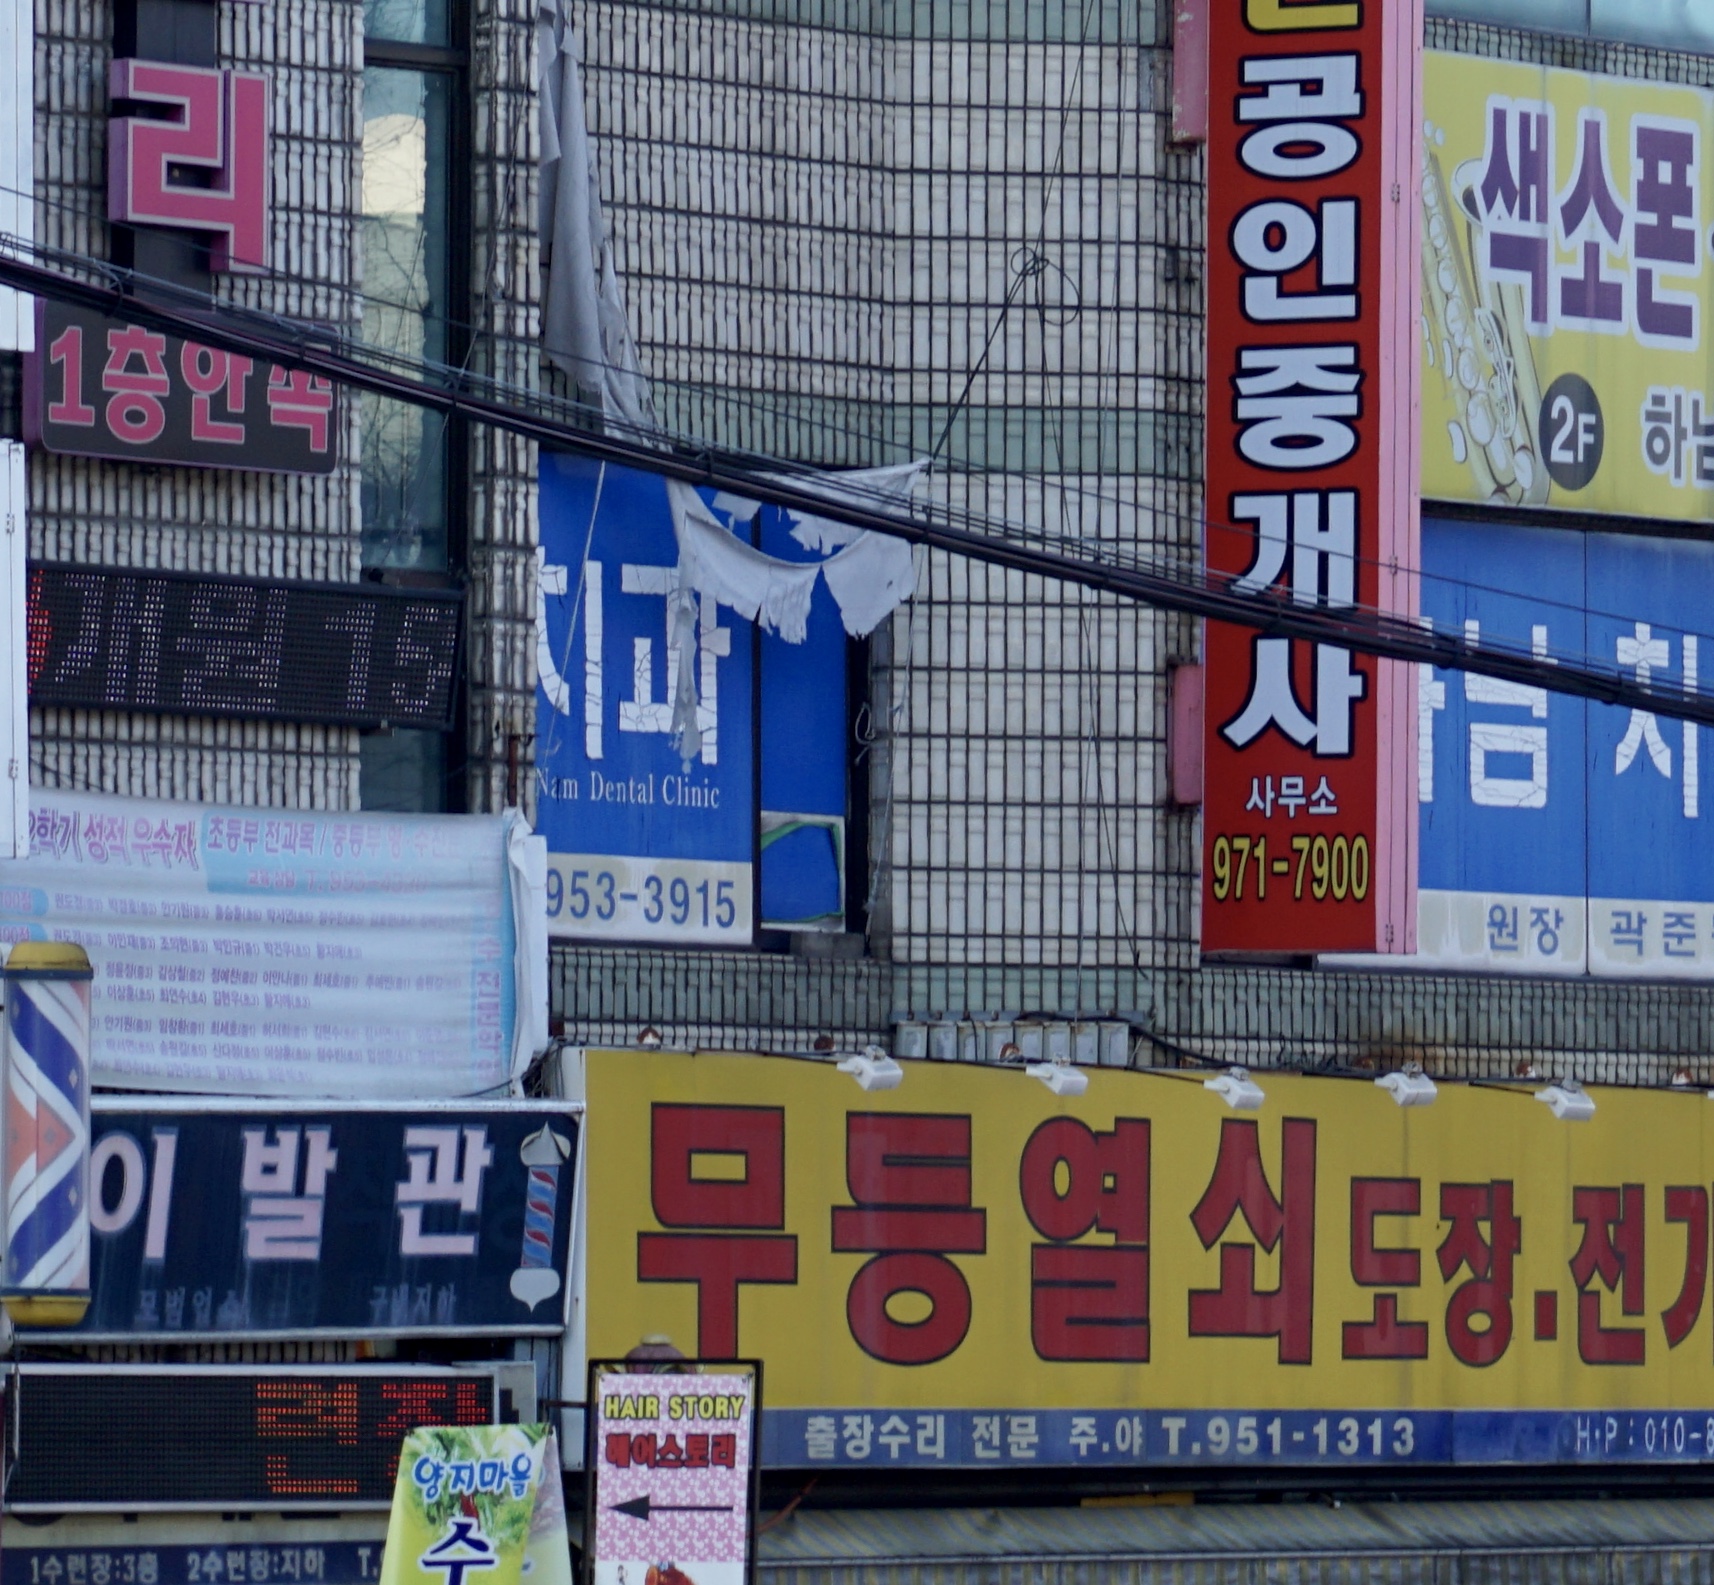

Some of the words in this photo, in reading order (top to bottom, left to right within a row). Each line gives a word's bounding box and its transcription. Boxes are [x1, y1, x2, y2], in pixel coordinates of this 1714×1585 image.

[108, 57, 272, 273] 리
[48, 325, 333, 453] 1층안쪽
[1218, 51, 1367, 757] 공인중개사
[1549, 402, 1597, 466] 2F
[590, 771, 654, 806] Dental
[662, 776, 720, 810] Clinic
[1245, 775, 1338, 818] 사무소
[84, 813, 131, 866] 성적
[131, 817, 199, 871] 우수자
[207, 816, 260, 853] 초등부
[265, 820, 316, 855] 전과목
[1213, 834, 1370, 901] 971-7900
[546, 869, 736, 928] 953-3915
[1486, 904, 1564, 955] 원장
[637, 1102, 1318, 1366] 무등열쇠
[605, 1395, 660, 1420] HAIR
[668, 1395, 745, 1420] STORY
[605, 1432, 736, 1468] 헤어스토리
[804, 1414, 947, 1461] 출장수리
[971, 1415, 1040, 1461] 전문
[1161, 1416, 1415, 1456] T.951-1313
[413, 1451, 533, 1498] 양지마을
